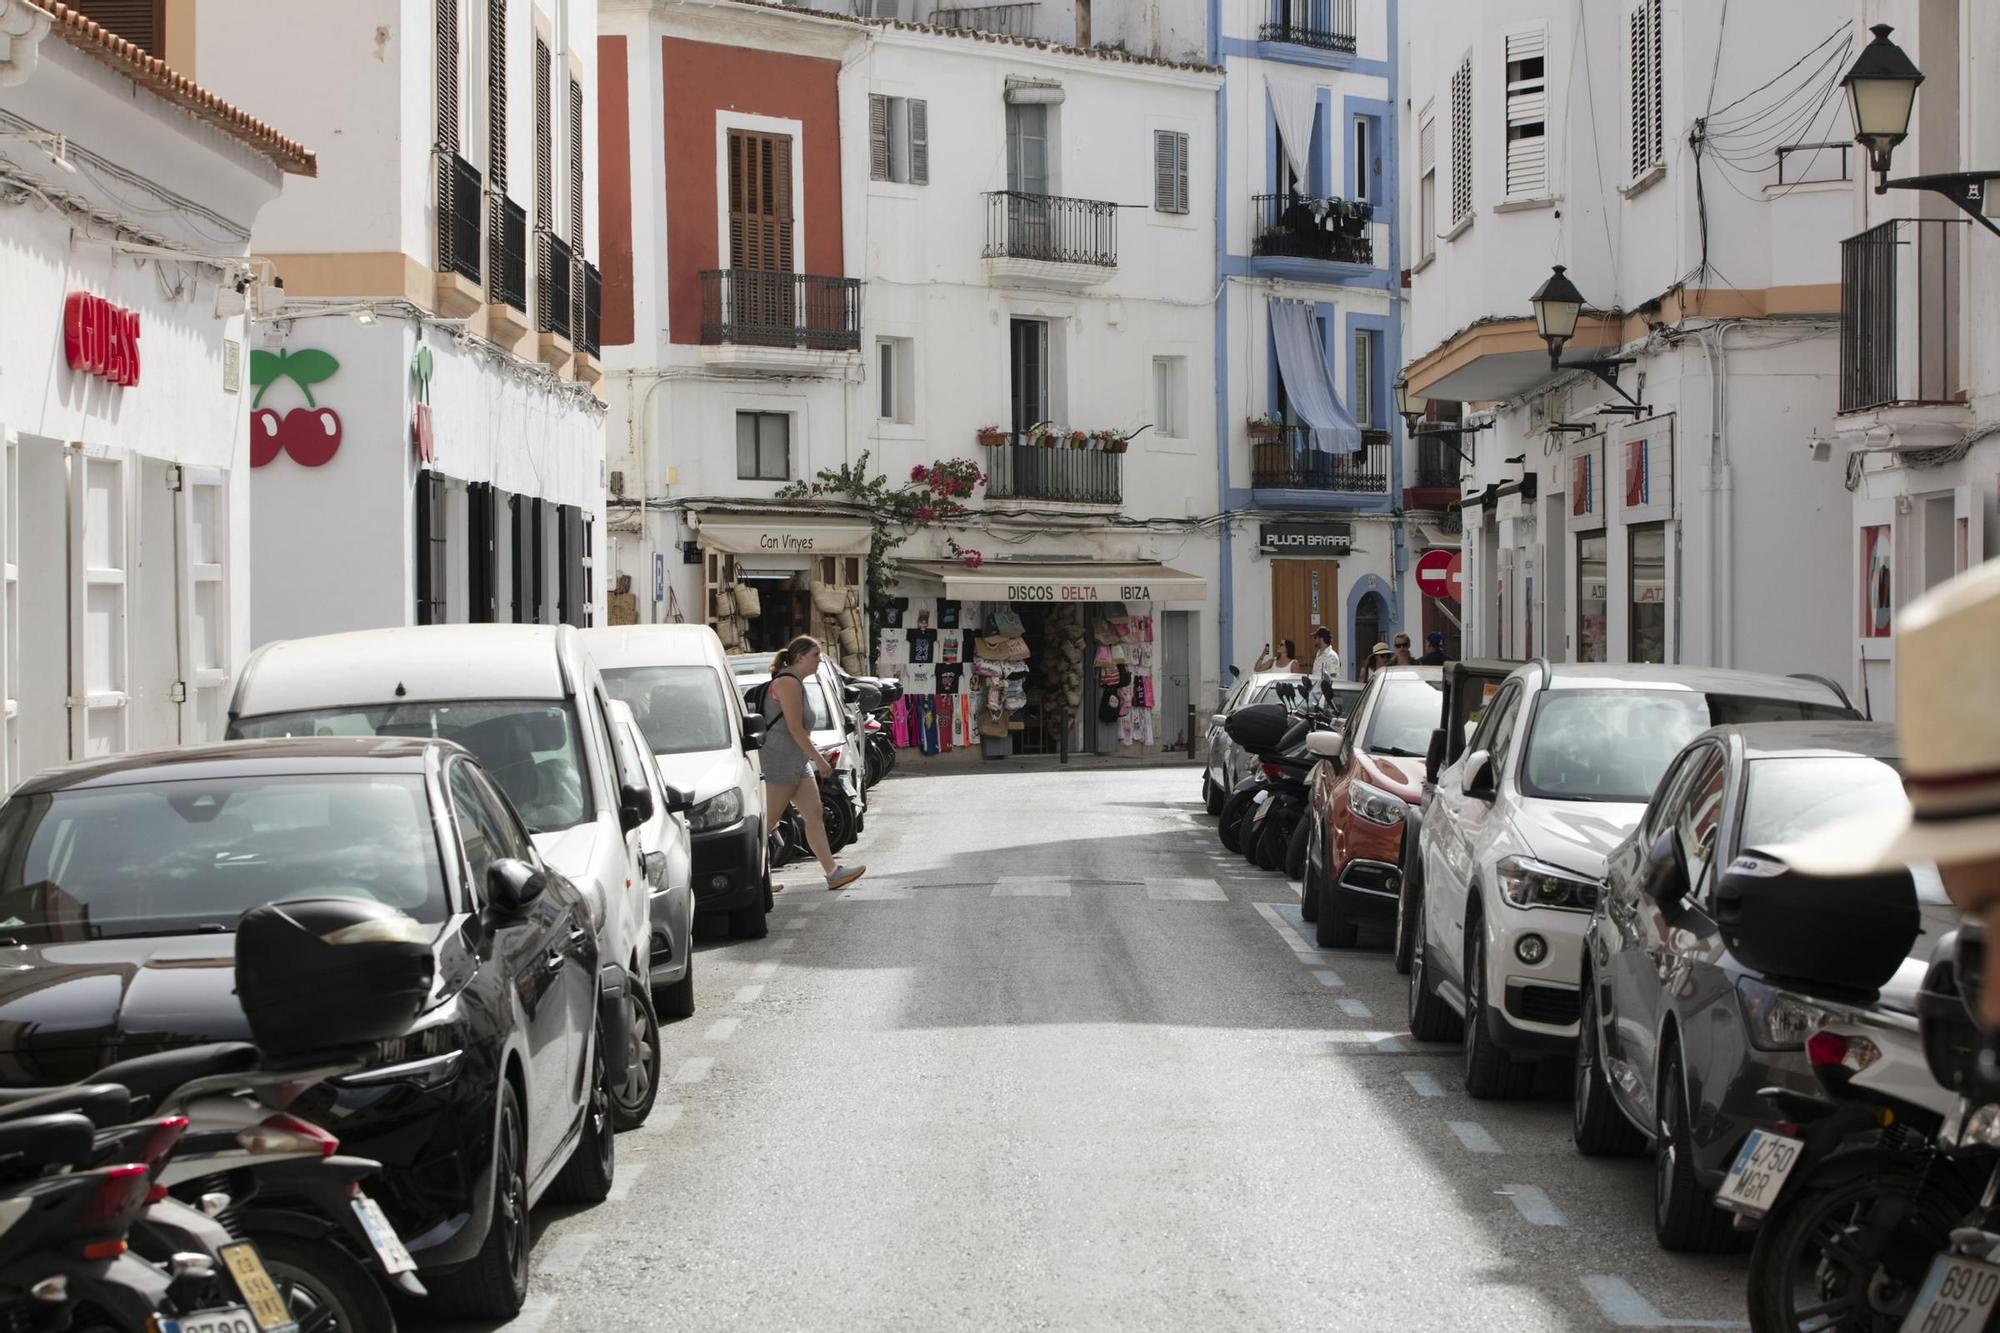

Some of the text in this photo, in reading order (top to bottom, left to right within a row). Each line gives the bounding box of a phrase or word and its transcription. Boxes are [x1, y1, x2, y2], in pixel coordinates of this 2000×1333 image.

[64, 291, 141, 388] GUESS
[760, 534, 814, 553] Can Vinyes
[1266, 534, 1305, 545] PILUCA
[1008, 585, 1151, 601] DISCOS DELTA IBIZA
[1750, 1138, 1796, 1174] 4750
[1940, 1264, 1999, 1307] 6910
